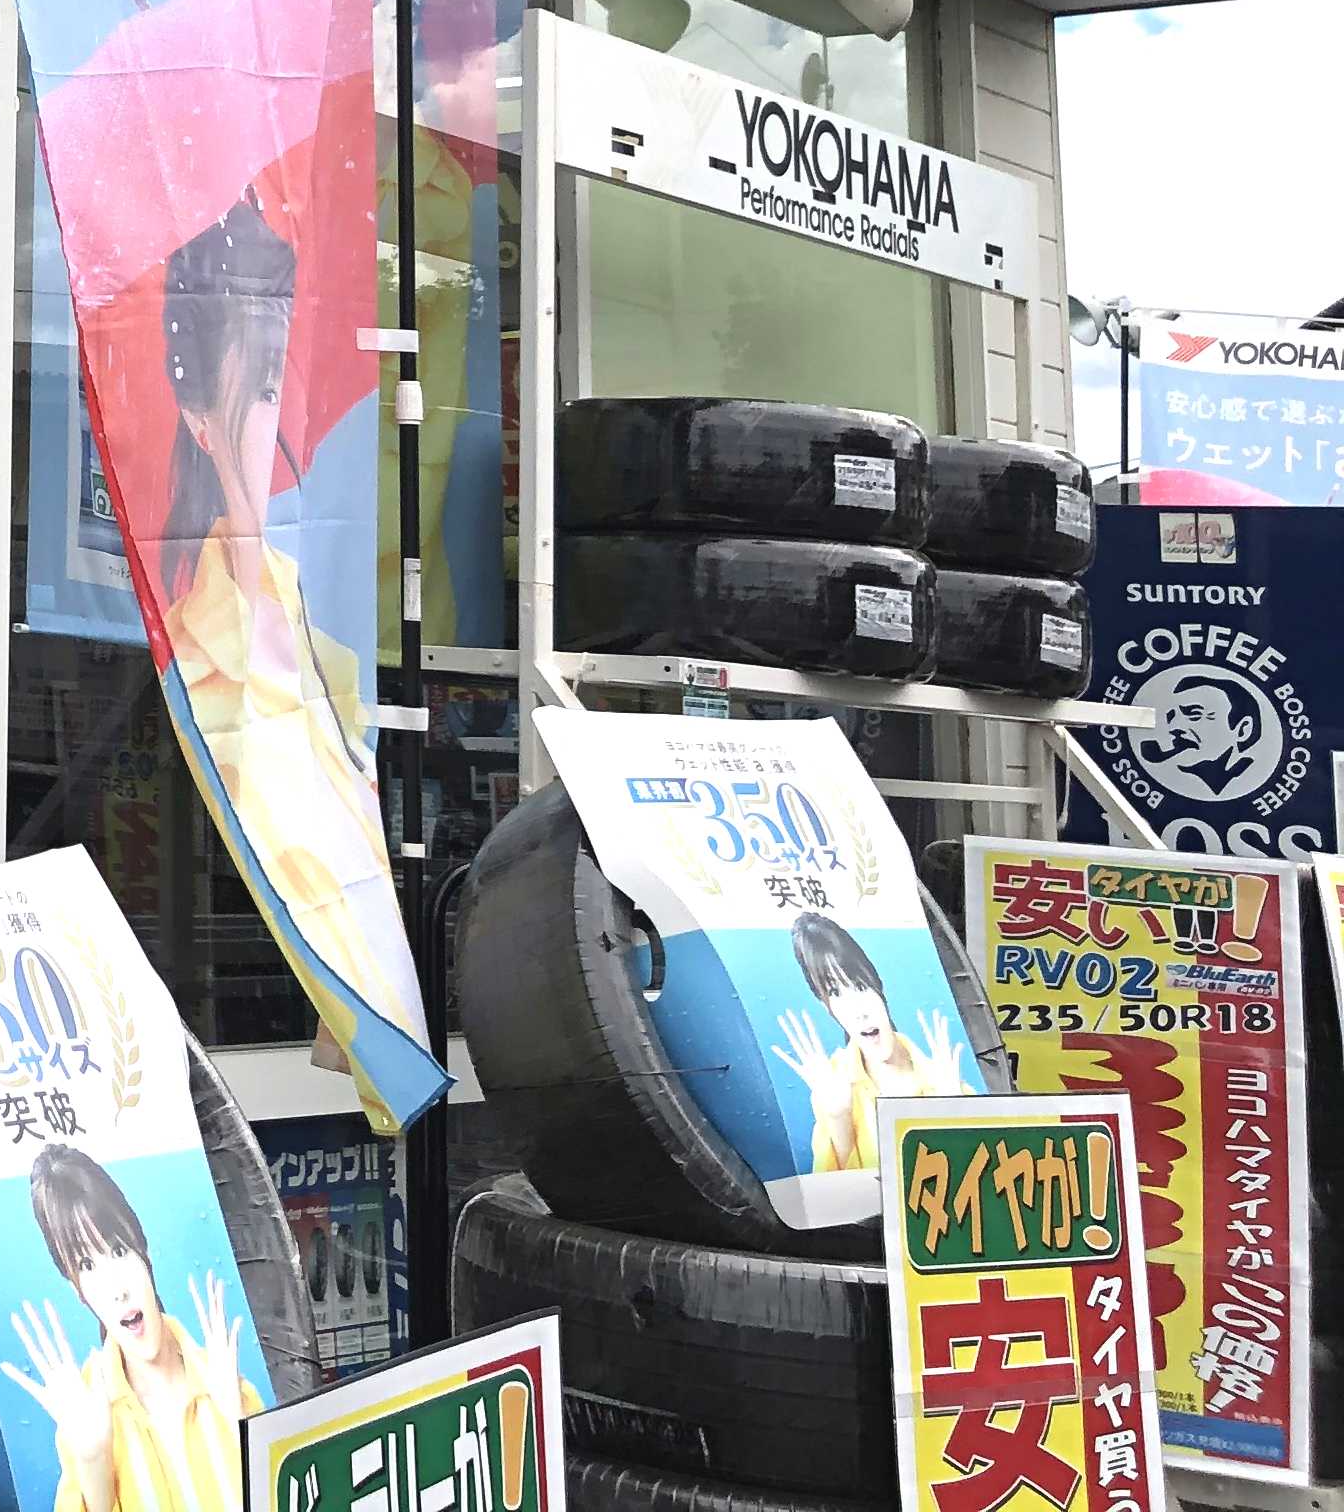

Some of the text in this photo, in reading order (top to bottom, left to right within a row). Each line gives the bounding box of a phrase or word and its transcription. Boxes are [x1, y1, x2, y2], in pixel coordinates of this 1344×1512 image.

[733, 88, 960, 233] YOKOHAMA
[740, 176, 921, 263] Performance Radials
[1218, 340, 1344, 372] YOKOHA
[1165, 389, 1344, 426] 安心感で選ぶ
[1126, 583, 1266, 606] SUNTORY
[1117, 623, 1287, 682] COFFEE
[1099, 674, 1165, 810] BOSS COEE
[1252, 682, 1312, 817] BOSS COFFEE
[686, 778, 830, 864] 350
[1100, 811, 1323, 862] OSS
[781, 846, 848, 872] サイズ
[763, 876, 835, 910] 突破
[994, 944, 1160, 1001] RV02
[1186, 964, 1276, 986] BluEarth
[997, 1003, 1278, 1034] 235/50R18
[17, 1036, 102, 1084] サイズ
